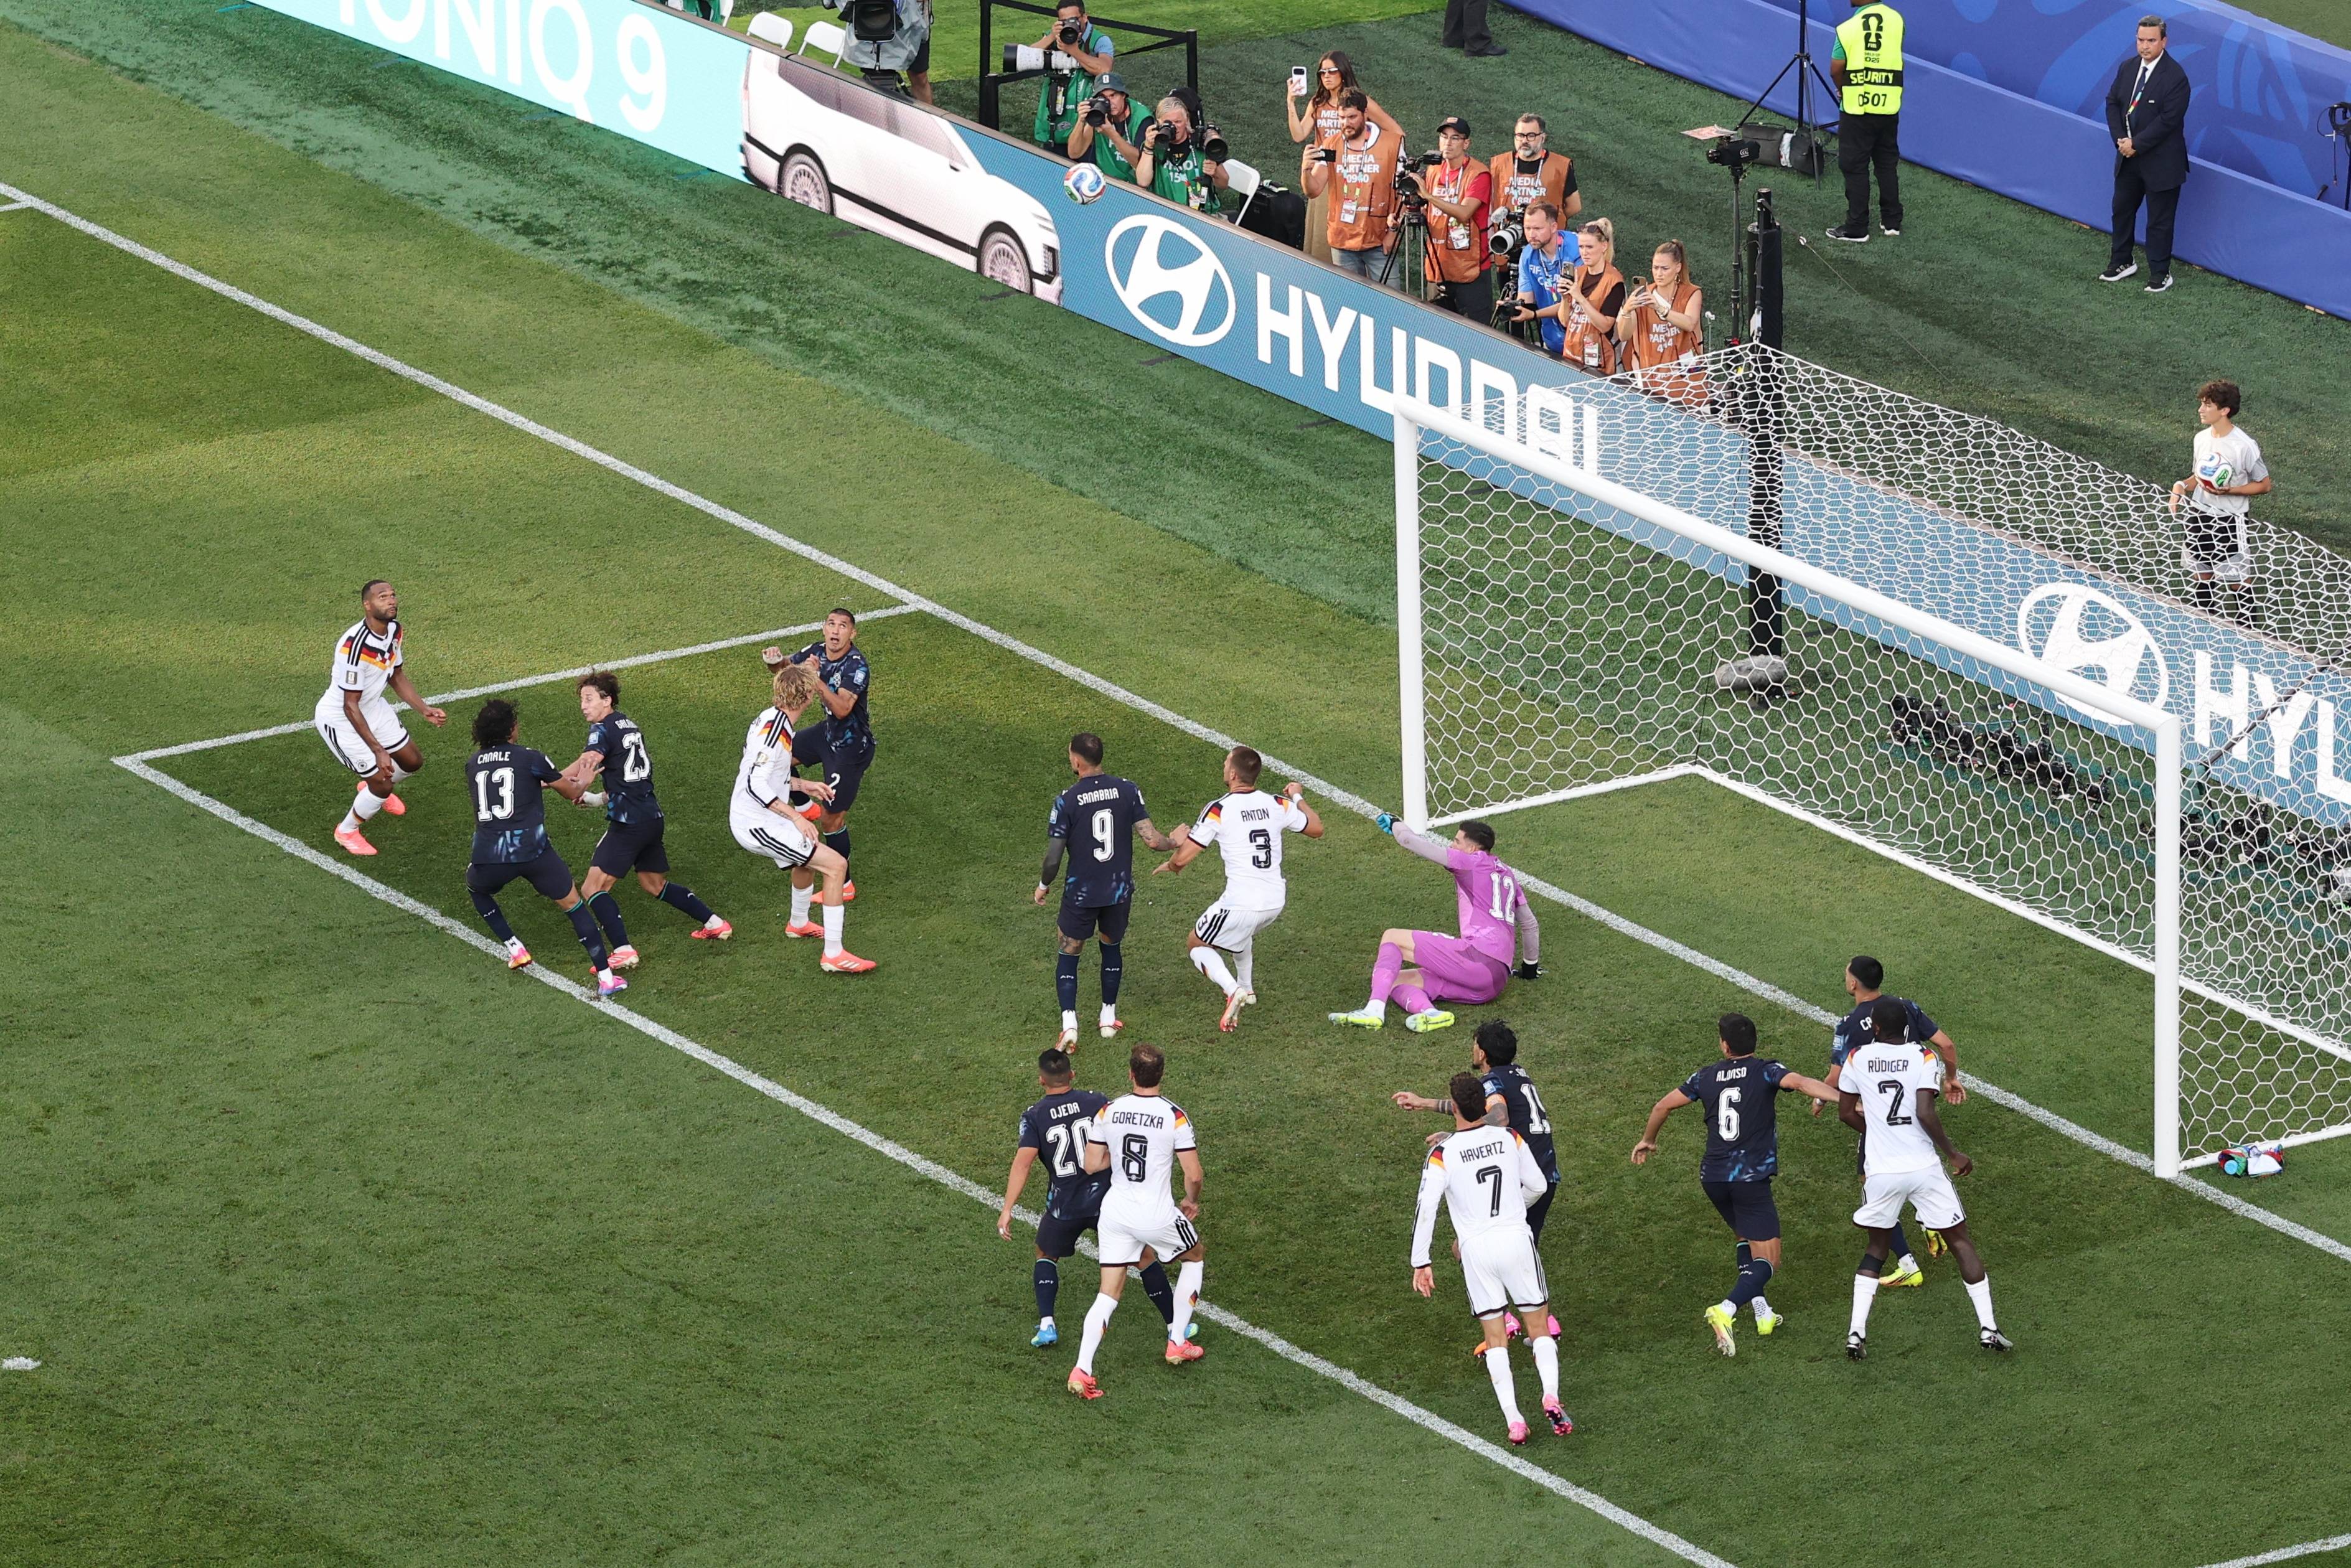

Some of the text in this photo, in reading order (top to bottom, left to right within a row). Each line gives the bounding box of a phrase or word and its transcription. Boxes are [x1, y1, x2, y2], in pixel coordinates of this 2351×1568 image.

[617, 13, 667, 133] 9
[1849, 70, 1893, 84] SEURITY
[1858, 91, 1887, 107] 0507
[1342, 154, 1375, 163] MEDIA
[1336, 164, 1380, 174] PARTNER
[1504, 187, 1547, 196] PARTNER
[1509, 177, 1542, 187] MEDIA
[477, 751, 511, 764] CANALE
[622, 731, 650, 782] 23
[475, 767, 515, 822] 13
[1077, 787, 1119, 805] SANABRIA
[1242, 808, 1270, 822] ANTON
[1092, 809, 1115, 862] 9
[1249, 829, 1272, 869] 3
[1489, 871, 1515, 926] 12
[1716, 1066, 1747, 1082] ALONSO
[1868, 1058, 1909, 1073] RÜDIGER
[1049, 1102, 1080, 1120] OJEDA
[1877, 1079, 1912, 1126] 2
[1112, 1111, 1164, 1130] GORETZKA
[1718, 1086, 1741, 1141] 6
[1046, 1116, 1094, 1178] 20
[1459, 1140, 1505, 1163] HAVERTZ
[1122, 1133, 1148, 1183] 8
[1475, 1165, 1503, 1218] 7
